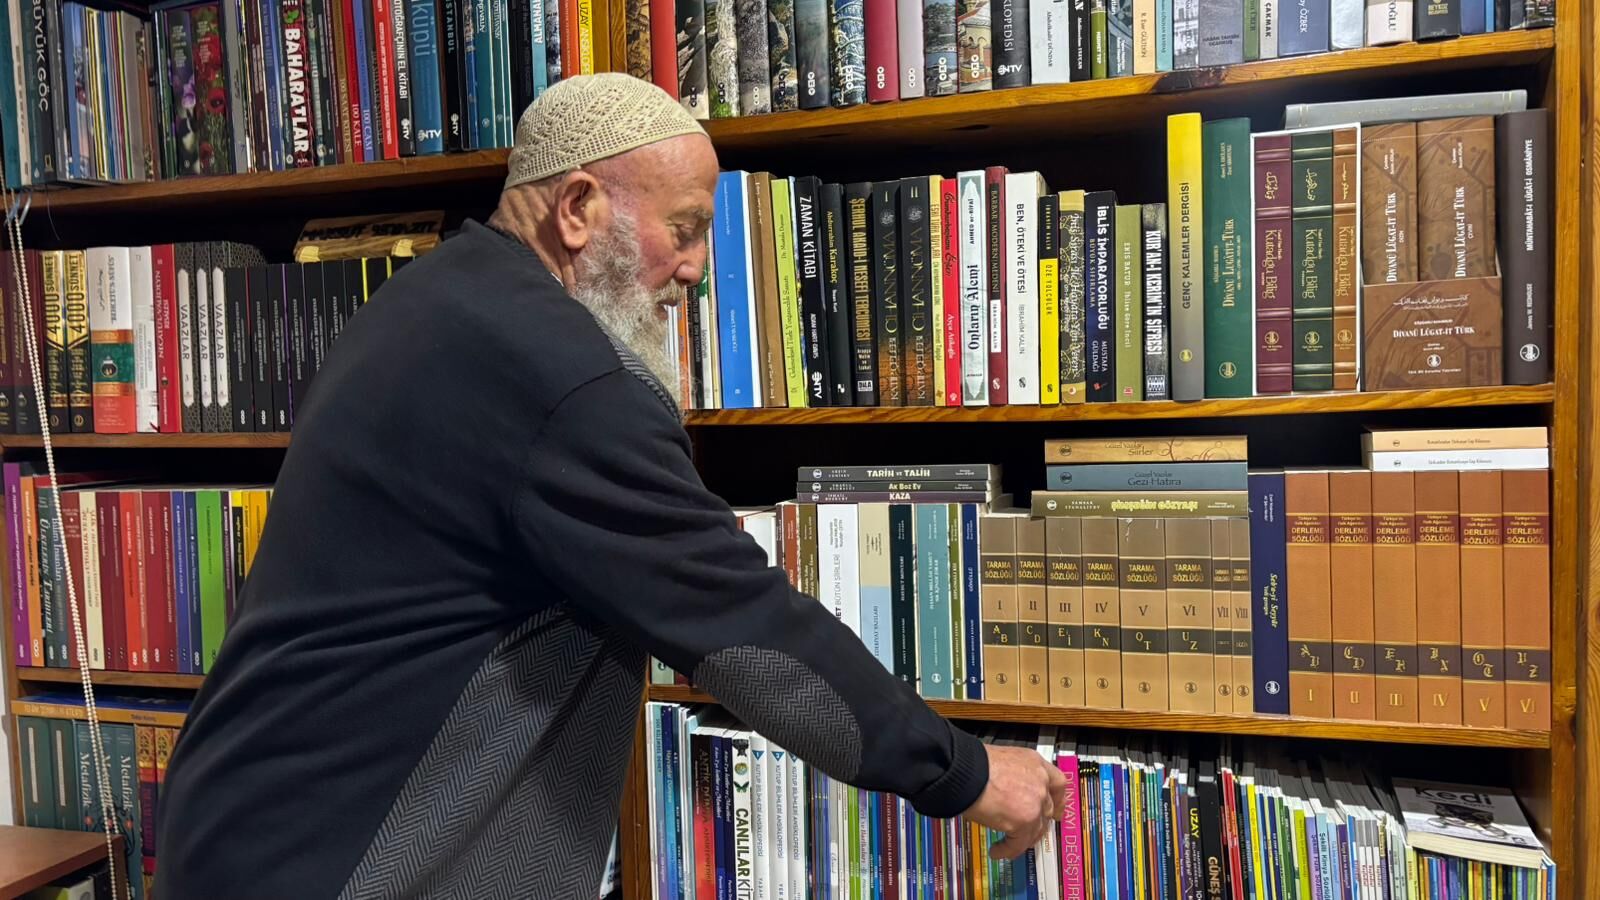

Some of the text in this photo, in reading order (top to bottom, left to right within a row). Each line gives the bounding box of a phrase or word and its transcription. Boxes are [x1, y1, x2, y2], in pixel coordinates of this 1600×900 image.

[579, 2, 589, 27] UZAY
[1264, 3, 1272, 38] ÇAKMAK
[1299, 9, 1308, 34] ÖZBEK
[37, 67, 49, 113] GÖÇ
[285, 28, 309, 154] BAHARATLAR
[399, 79, 411, 99] KİTABI
[362, 109, 371, 125] 100
[352, 103, 363, 148] 100 KALE
[1383, 193, 1397, 215] TÜRK
[1451, 186, 1465, 210] TÜRK
[799, 197, 817, 279] ZAMAN KİTABI
[990, 190, 1001, 294] BARBAR MODERN MEDENİ
[1178, 181, 1194, 310] GENÇ KALEMLER DERGİSİ
[1015, 203, 1028, 295] BEN, ÖTEKİ VE ÖTESİ
[829, 249, 841, 284] Karakoç
[1095, 206, 1110, 331] İBLİS İMPARATORLUĞU
[1259, 229, 1281, 299] Kutadgu Bilig
[1299, 229, 1321, 299] Kutadgu Bilig
[1335, 226, 1354, 297] Kutadgu Bilig
[1386, 252, 1398, 282] DİVANÜ
[1455, 247, 1467, 277] DİVANÜ
[854, 265, 868, 294] NESEFİ
[1088, 238, 1098, 309] BÜYÜK SIFIRLAMA
[1124, 260, 1132, 286] BATUR
[66, 255, 86, 334] 4000 SÜNNET
[1045, 264, 1055, 317] ÖZE YOLCULUK
[1144, 229, 1165, 356] KUR'AN-I KERİM'İN ŞİFRESİ
[855, 295, 869, 342] TERCÜMESİ
[181, 303, 191, 361] VAAZLAR
[199, 303, 209, 361] VAAZLAR
[215, 303, 225, 361] VAAZLAR
[1018, 304, 1027, 356] İBRAHİM KALIN
[1393, 327, 1418, 338] DİVANÜ
[1455, 323, 1476, 335] TÜRK
[1091, 341, 1102, 373] GÜLDAĞI
[1099, 341, 1109, 373] MUSTAFA
[867, 466, 930, 478] TARİH TALİH
[889, 482, 921, 491] Ak Boz Ev
[889, 492, 912, 501] KAZA
[51, 517, 63, 542] Bilim
[1291, 526, 1324, 535] DERLEME
[1334, 526, 1368, 536] DERLEME
[1375, 526, 1411, 536] DERLEME
[1418, 525, 1455, 535] DERLEME
[1462, 528, 1499, 537] DERLEME
[1505, 527, 1544, 536] DERLEME
[1291, 534, 1325, 544] SÖZLÜĞÜ
[1334, 534, 1369, 544] SÖZLÜĞÜ
[1375, 534, 1411, 544] SÖZLÜĞÜ
[1418, 533, 1455, 543] SÖZLÜĞÜ
[1462, 535, 1500, 546] SÖZLÜĞÜ
[1505, 534, 1544, 546] SÖZLÜĞÜ
[40, 517, 53, 575] ÜLKELERİN
[985, 560, 1011, 570] TARAMA
[1019, 560, 1044, 571] TARAMA
[1051, 562, 1078, 572] TARAMA
[1086, 562, 1113, 572] TARAMA
[1127, 564, 1155, 573] TARAMA
[1173, 563, 1201, 573] TARAMA
[984, 569, 1013, 579] SÖZLÜĞÜ
[1018, 570, 1045, 580] SÖZLÜĞÜ
[1050, 571, 1079, 581] SÖZLÜĞÜ
[1085, 571, 1115, 582] SÖZLÜĞÜ
[1126, 573, 1158, 584] SÖZLÜĞÜ
[1172, 572, 1204, 584] SÖZLÜĞÜ
[997, 600, 1002, 611] I
[1028, 600, 1038, 611] II
[1058, 602, 1071, 613] III
[1094, 602, 1108, 614] IV
[1138, 605, 1148, 617] V
[1182, 605, 1196, 617] VI
[1216, 606, 1228, 619] VII
[1233, 607, 1247, 620] VIII
[992, 625, 1001, 634] A
[1025, 626, 1034, 635] C
[1058, 628, 1065, 637] E
[1094, 629, 1102, 638] K
[1135, 632, 1143, 642] O
[1182, 632, 1190, 641] U
[1000, 634, 1008, 643] B
[1034, 635, 1041, 644] D
[1067, 632, 1072, 646] İ
[1102, 638, 1109, 648] N
[1143, 642, 1151, 651] T
[1189, 642, 1198, 651] Z
[1307, 689, 1313, 702] I
[1349, 691, 1359, 704] II
[1388, 693, 1403, 707] III
[1432, 693, 1448, 707] IV
[1478, 697, 1490, 712] V
[1518, 698, 1535, 713] VI
[699, 748, 712, 784] ANTİK
[79, 751, 95, 808] Metafizik
[119, 757, 134, 812] Metafizik
[756, 784, 764, 813] BİLİMLERİ
[776, 785, 784, 814] BİLİMLERİ
[793, 787, 801, 816] BİLİMLERİ
[1063, 771, 1077, 830] DÜNYAYI
[1103, 779, 1114, 842] BU DOĞRU OLAMAZ!
[1189, 807, 1200, 838] UZAY
[735, 807, 751, 877] CANLILAR
[756, 814, 765, 857] ANSİKLOPEDİSİ
[776, 815, 785, 858] ANSİKLOPEDİSİ
[793, 817, 802, 860] ANSİKLOPEDİSİ
[1207, 856, 1222, 893] GÜNEŞ
